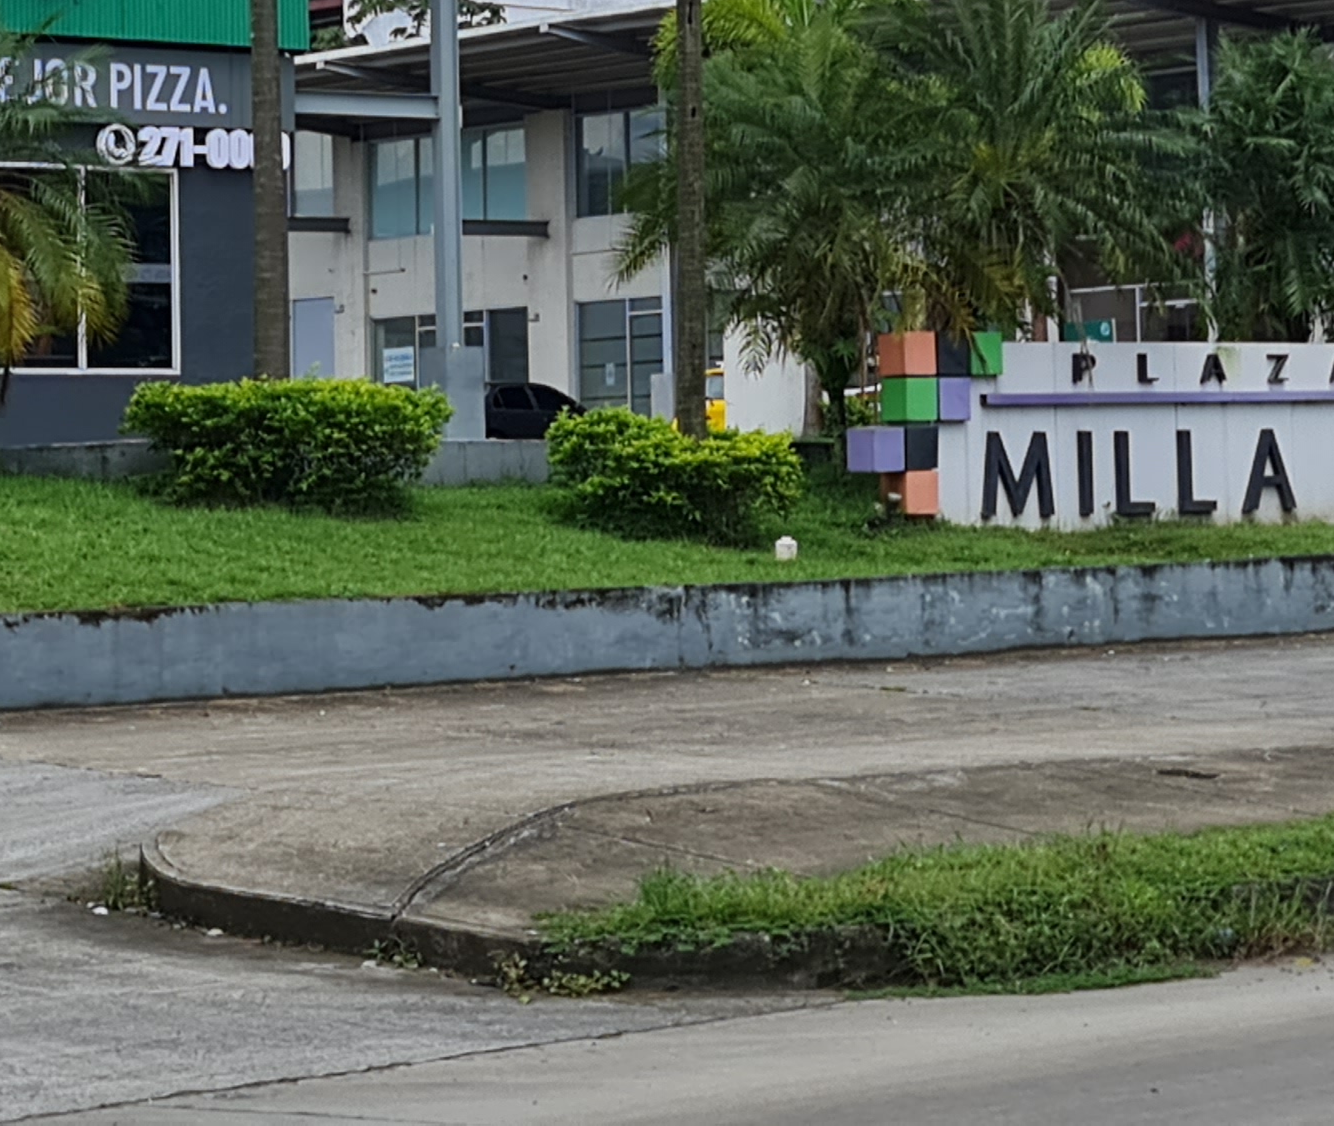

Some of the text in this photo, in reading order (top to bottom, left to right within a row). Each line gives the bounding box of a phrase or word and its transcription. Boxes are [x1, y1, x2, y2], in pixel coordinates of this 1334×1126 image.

[109, 61, 228, 115] PIZZA.
[137, 125, 291, 171] 271-00
[980, 428, 1298, 519] MILLA
